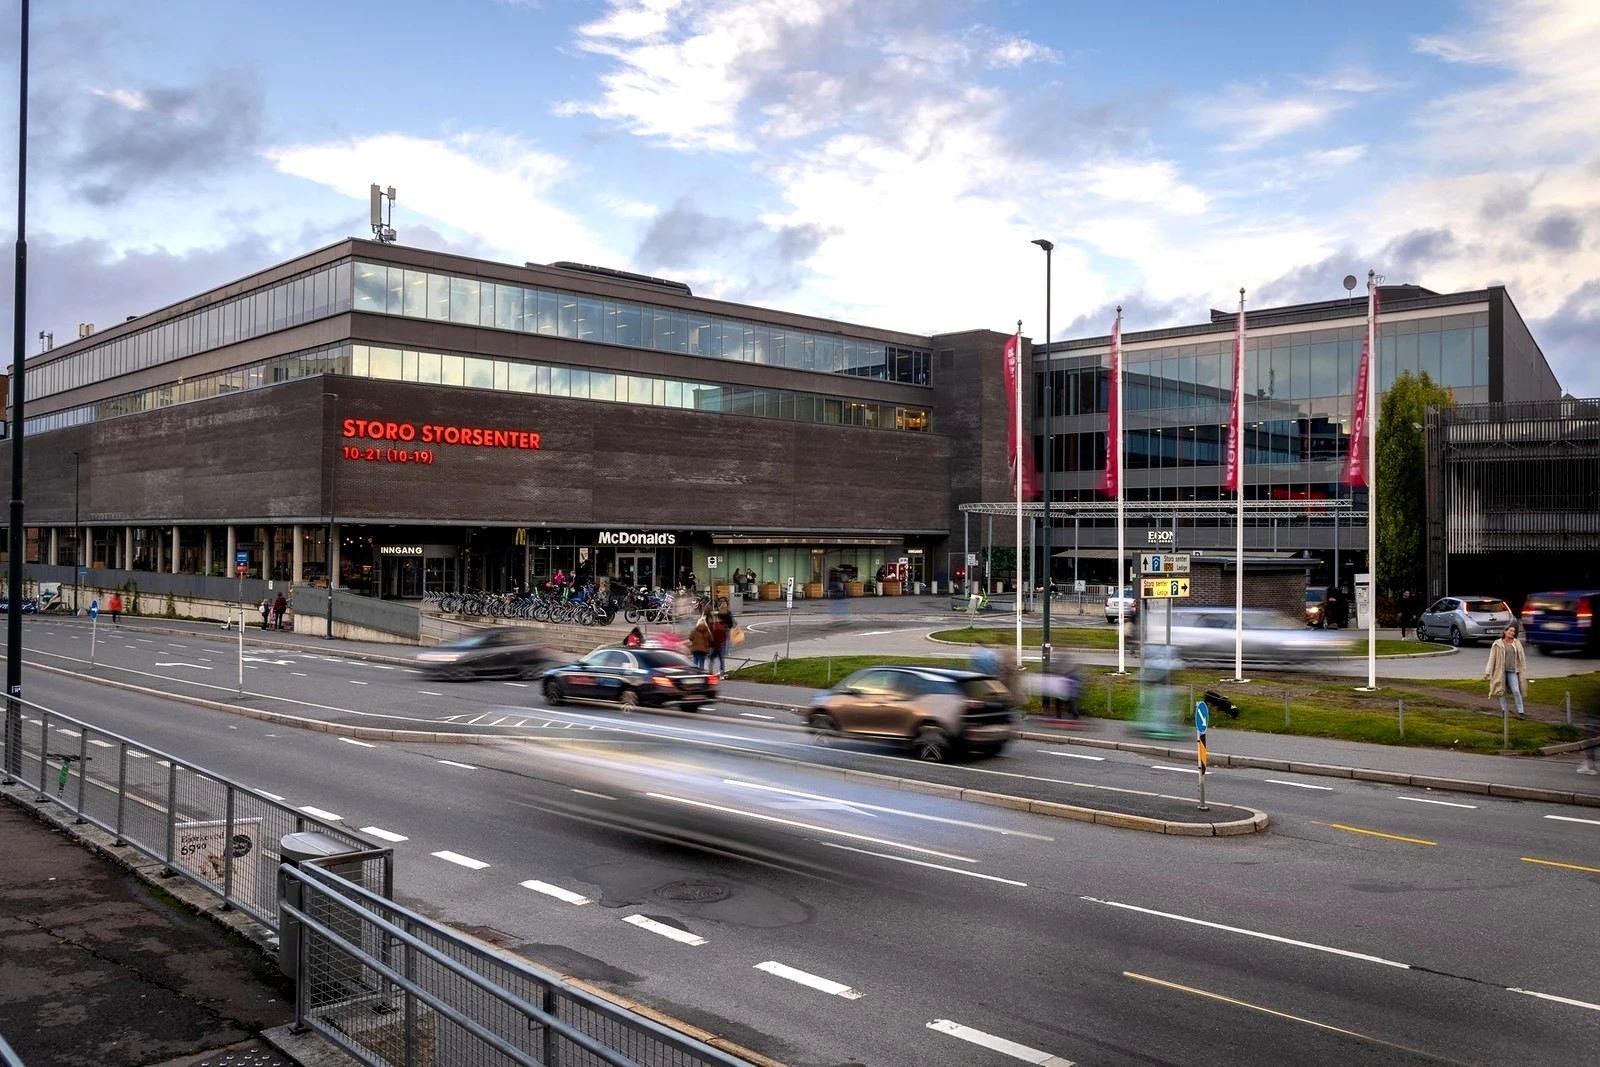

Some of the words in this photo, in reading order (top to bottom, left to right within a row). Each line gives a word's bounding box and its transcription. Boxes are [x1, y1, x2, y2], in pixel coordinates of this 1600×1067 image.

[343, 419, 416, 441] STORO
[421, 424, 541, 449] STORSENTER
[343, 446, 381, 460] 10-21
[386, 448, 434, 465] (10-19)
[597, 531, 676, 545] McDonald's
[380, 546, 423, 555] INNGANG
